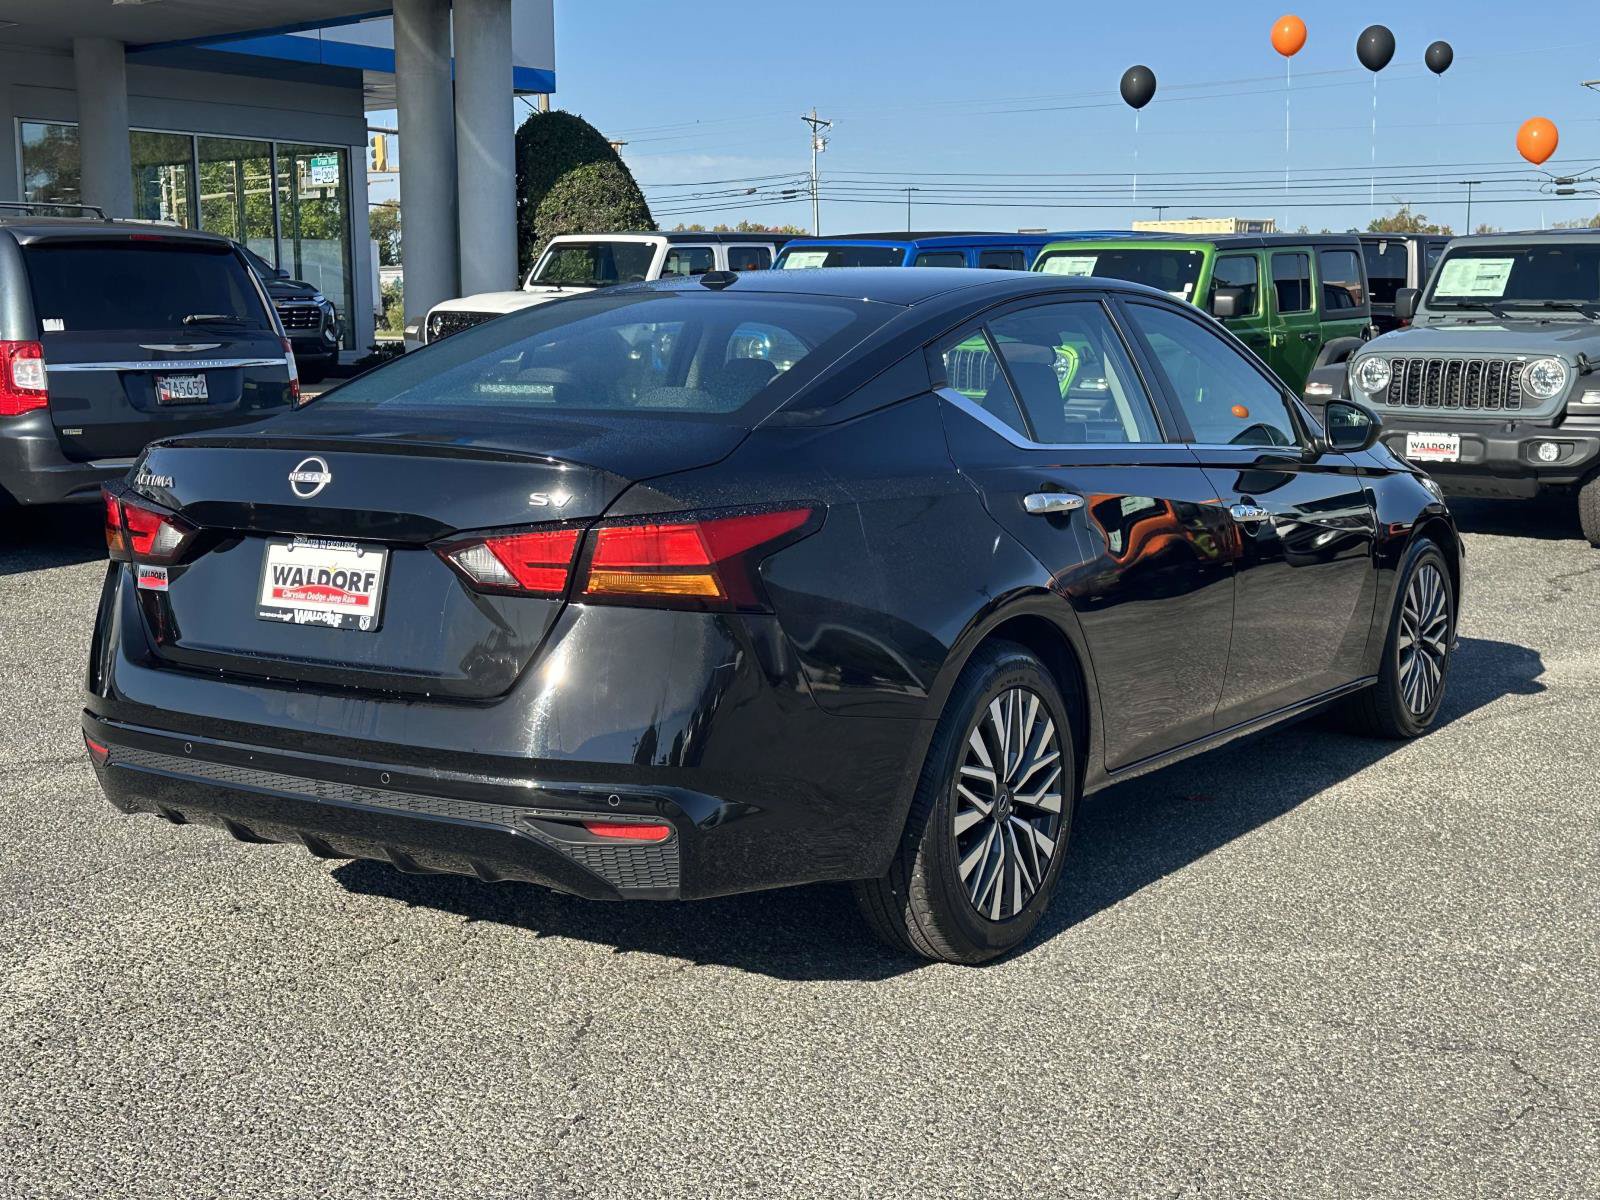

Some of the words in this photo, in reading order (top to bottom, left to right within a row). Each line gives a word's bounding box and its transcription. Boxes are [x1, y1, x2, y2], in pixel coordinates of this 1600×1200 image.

[1410, 442, 1457, 450] WALDORF
[134, 472, 175, 488] ALTIMA
[288, 471, 332, 483] NISSAN
[529, 491, 573, 509] SV
[273, 565, 376, 593] WALDORF
[282, 589, 306, 600] Chrysler
[306, 591, 326, 602] Dodge
[327, 594, 342, 604] Jeep
[342, 595, 357, 604] Ram
[294, 609, 343, 627] WALDORF
